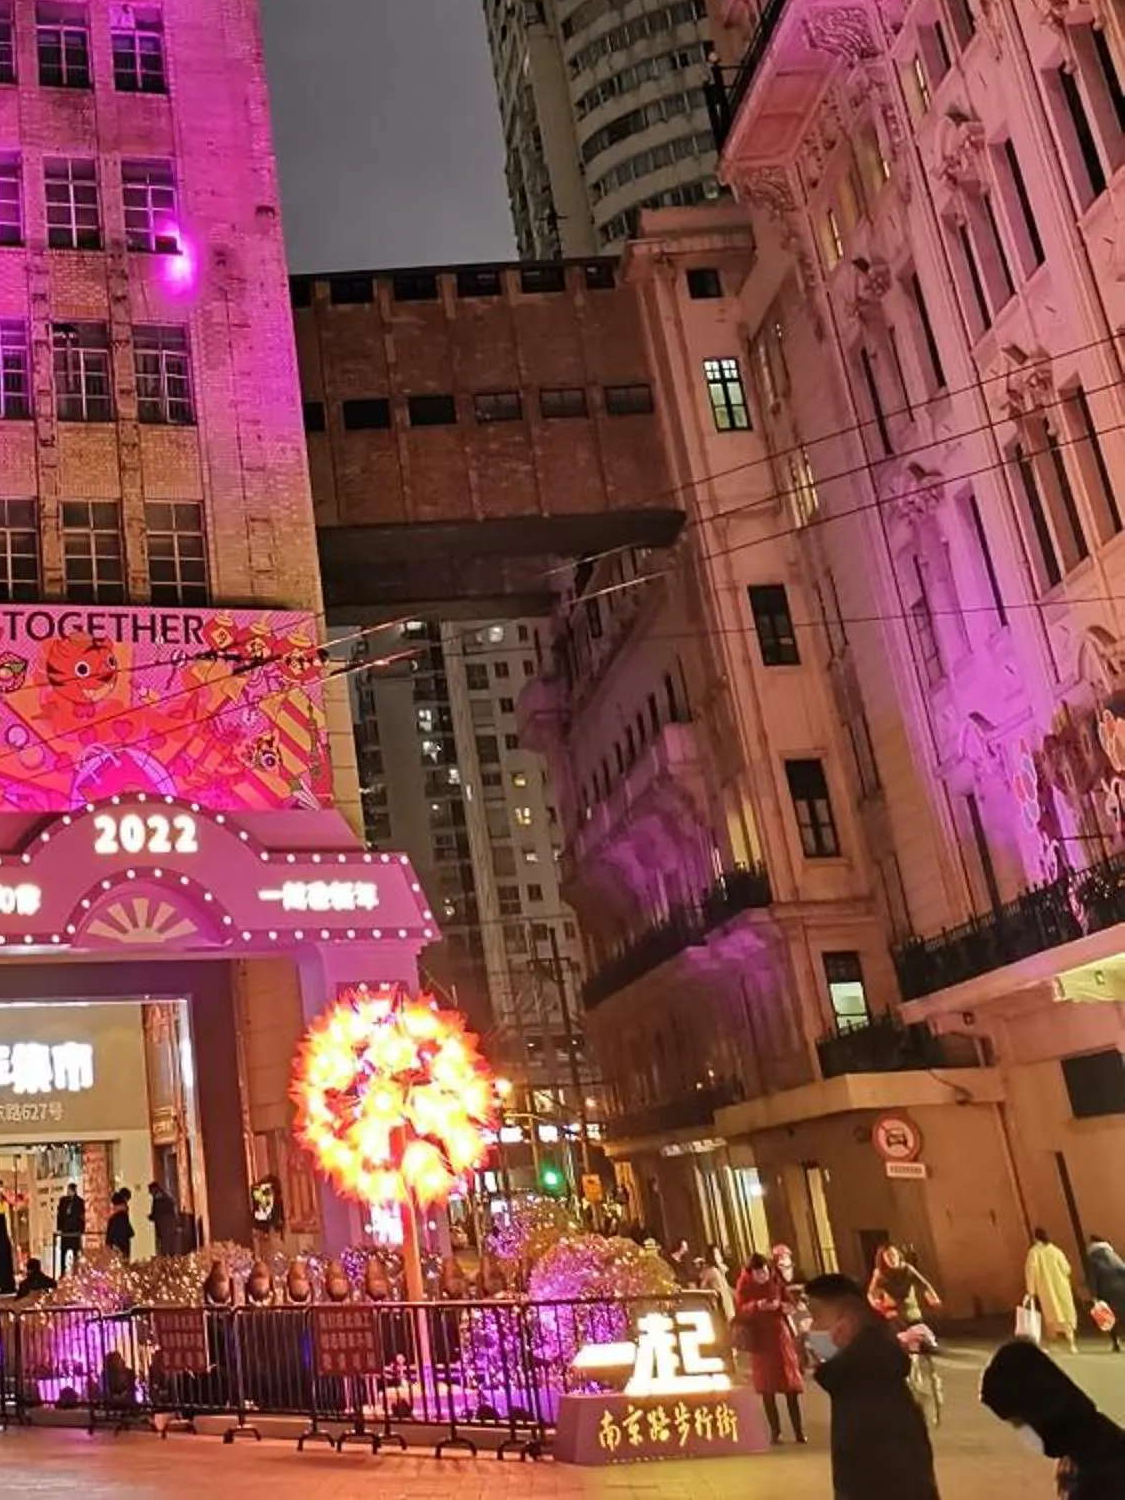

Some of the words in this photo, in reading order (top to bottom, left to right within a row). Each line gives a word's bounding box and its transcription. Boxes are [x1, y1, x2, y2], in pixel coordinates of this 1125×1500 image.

[4, 612, 205, 645] TOGETHER
[94, 814, 199, 853] 2022
[572, 1310, 731, 1396] 一起
[599, 1401, 738, 1451] 南京路步行街
